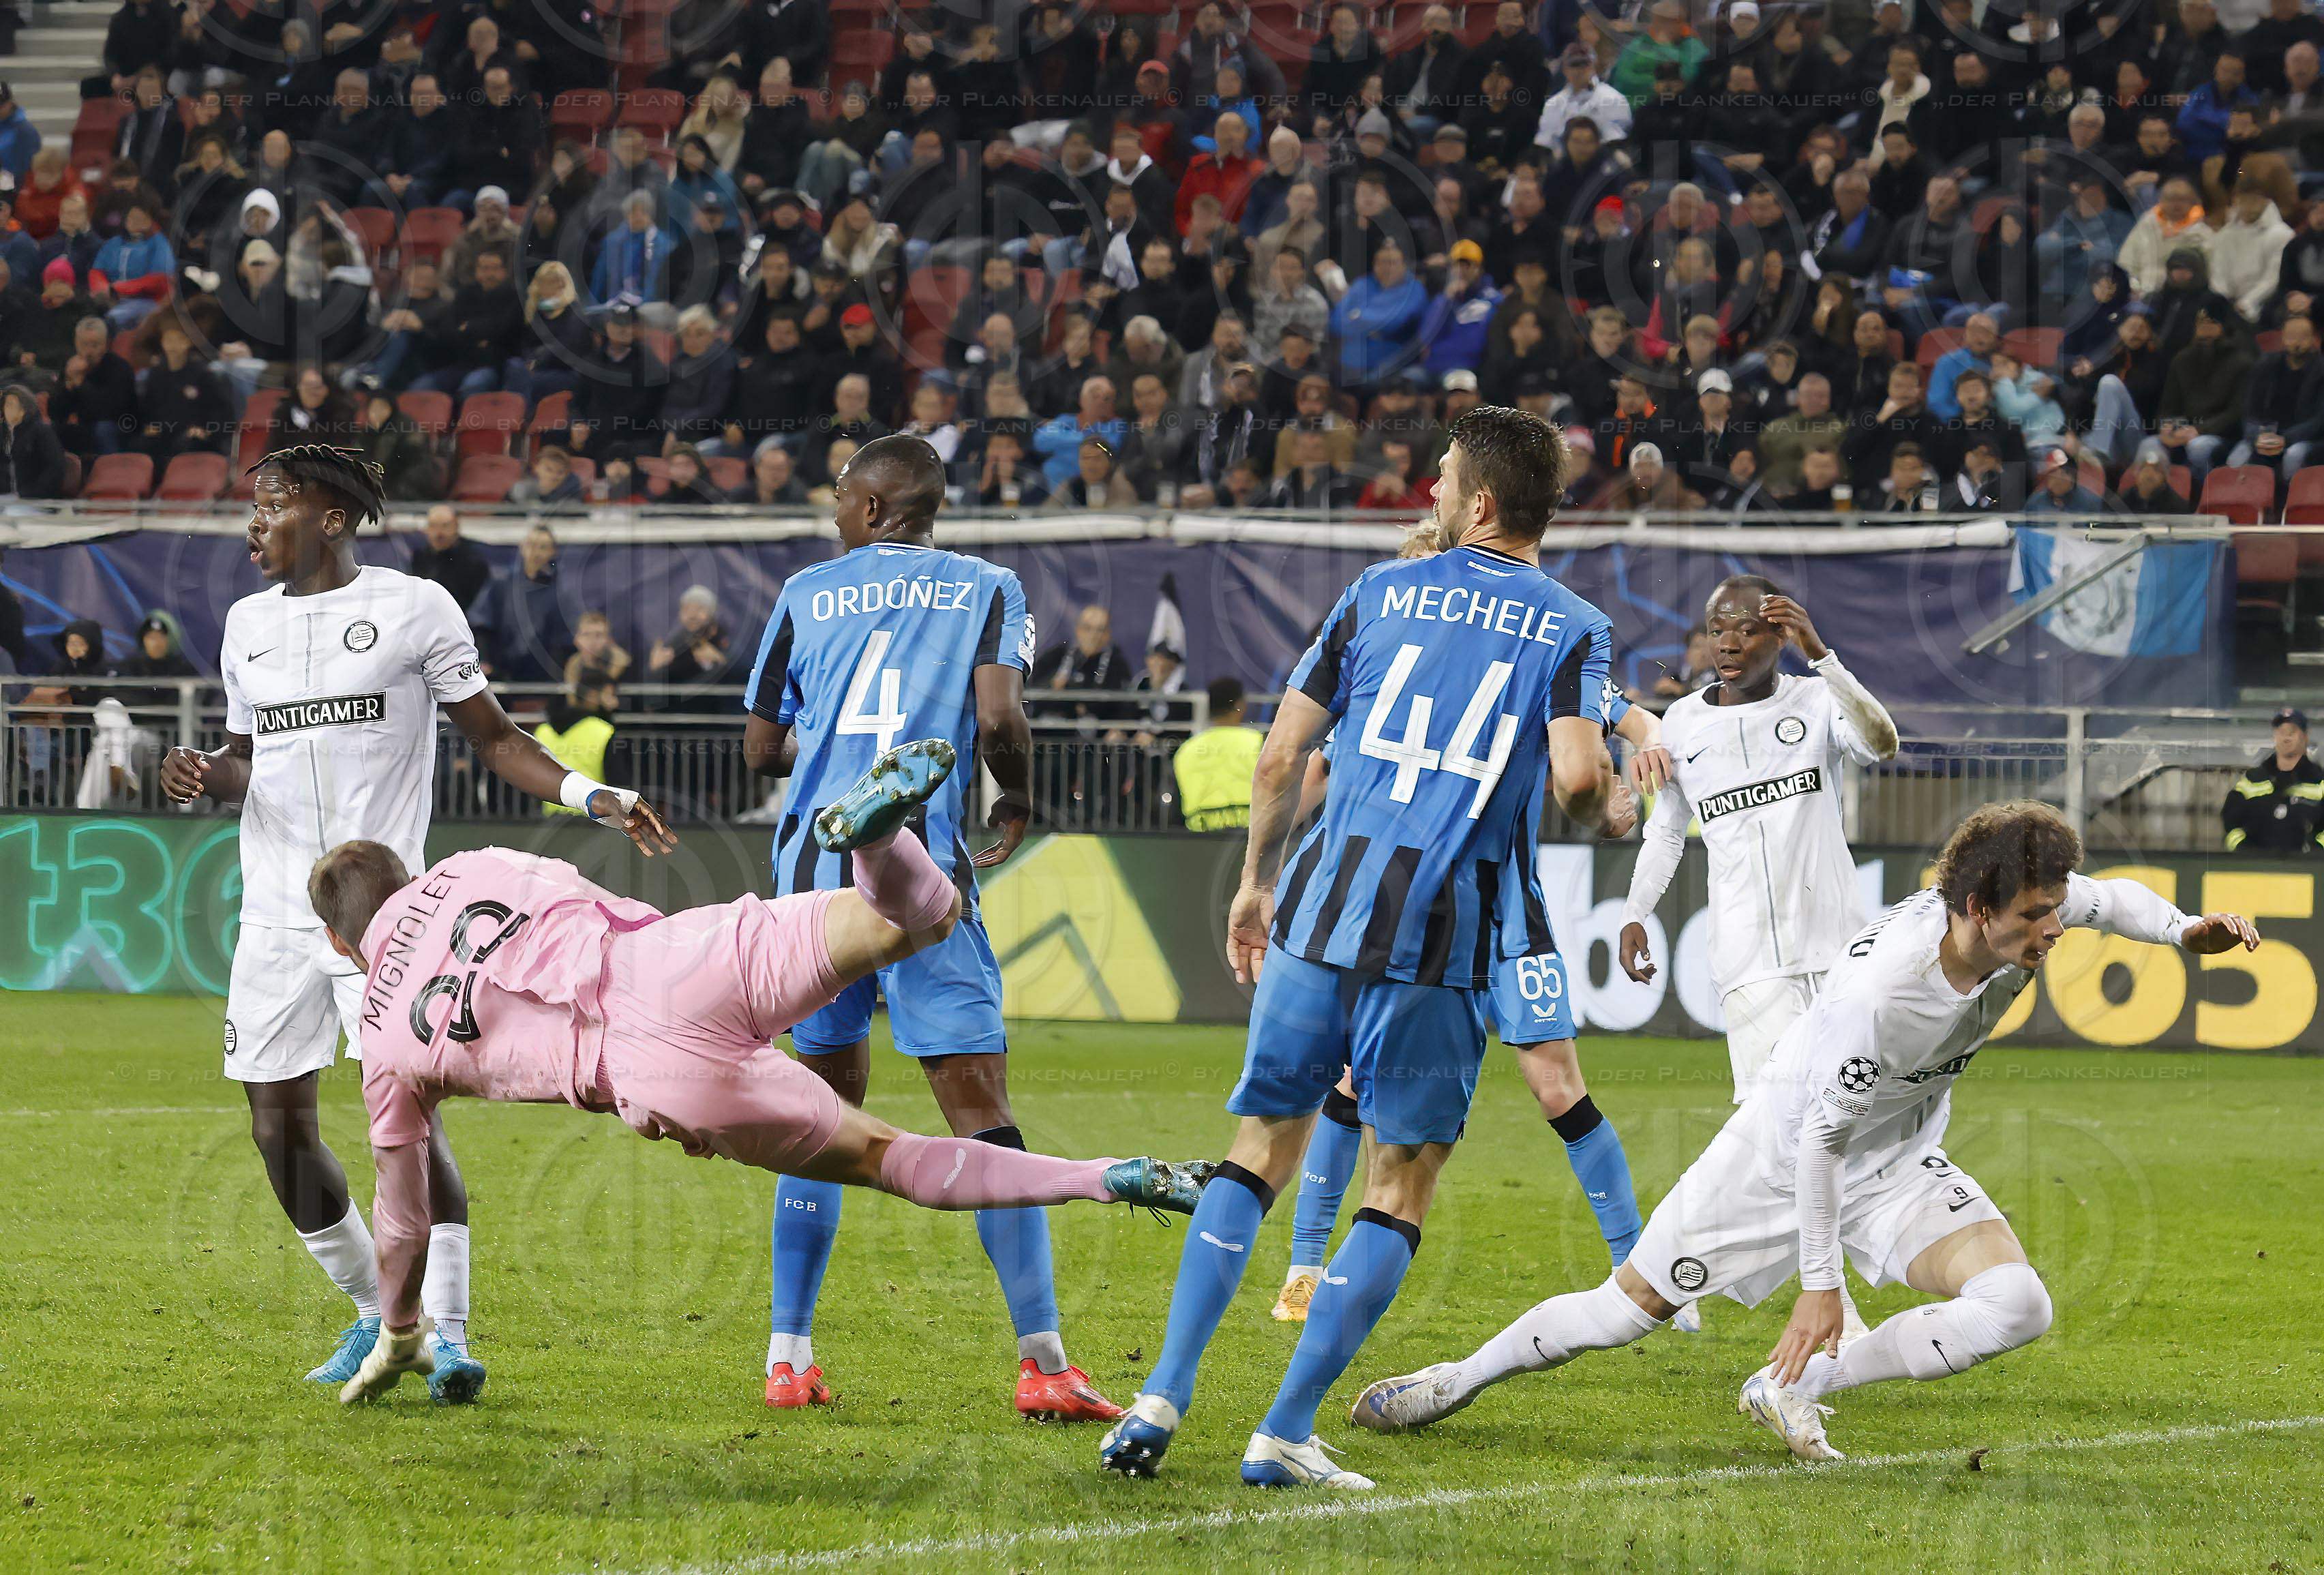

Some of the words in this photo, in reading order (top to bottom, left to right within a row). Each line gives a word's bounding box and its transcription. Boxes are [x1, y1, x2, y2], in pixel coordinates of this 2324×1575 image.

[812, 573, 974, 622] ORDÓÑEZ
[1380, 584, 1567, 646] MECHELE
[258, 698, 379, 734] PUNTIGAMER
[836, 630, 907, 760] 4
[1359, 643, 1519, 820] 44
[1702, 770, 1816, 822] PUNTIGAMER
[362, 869, 461, 1031] MIGNOLET
[1516, 952, 1562, 1000] 65
[785, 1197, 817, 1212] FCB
[1953, 1186, 1969, 1199] 9
